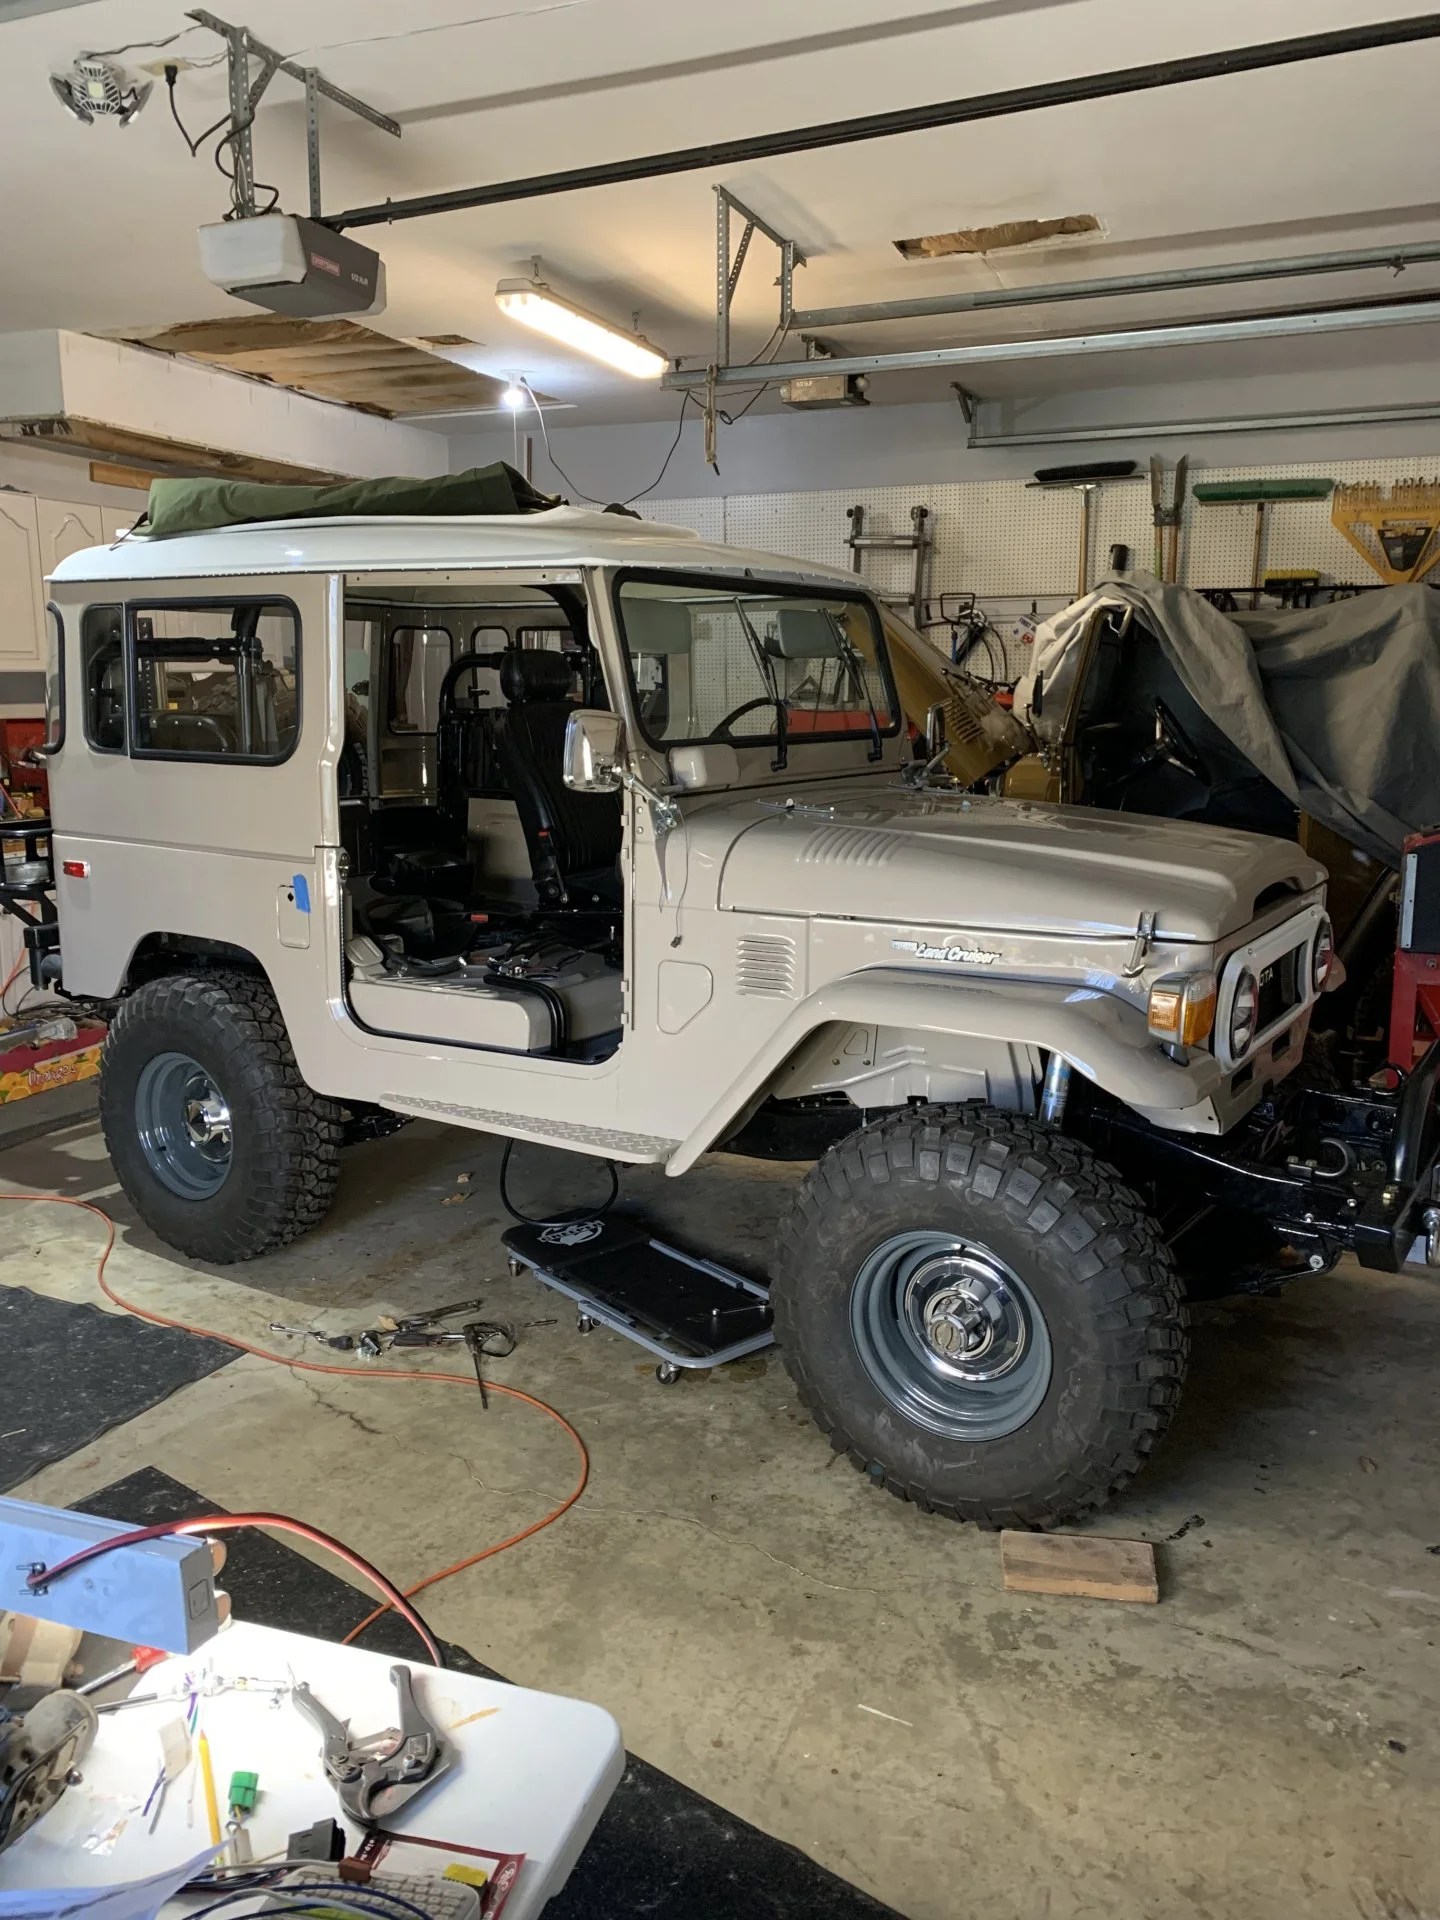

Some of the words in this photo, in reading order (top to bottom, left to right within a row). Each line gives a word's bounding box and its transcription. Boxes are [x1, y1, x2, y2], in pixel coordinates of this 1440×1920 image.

[915, 942, 949, 960] Land
[948, 945, 1002, 965] Cruiser
[28, 1065, 77, 1087] Oranges
